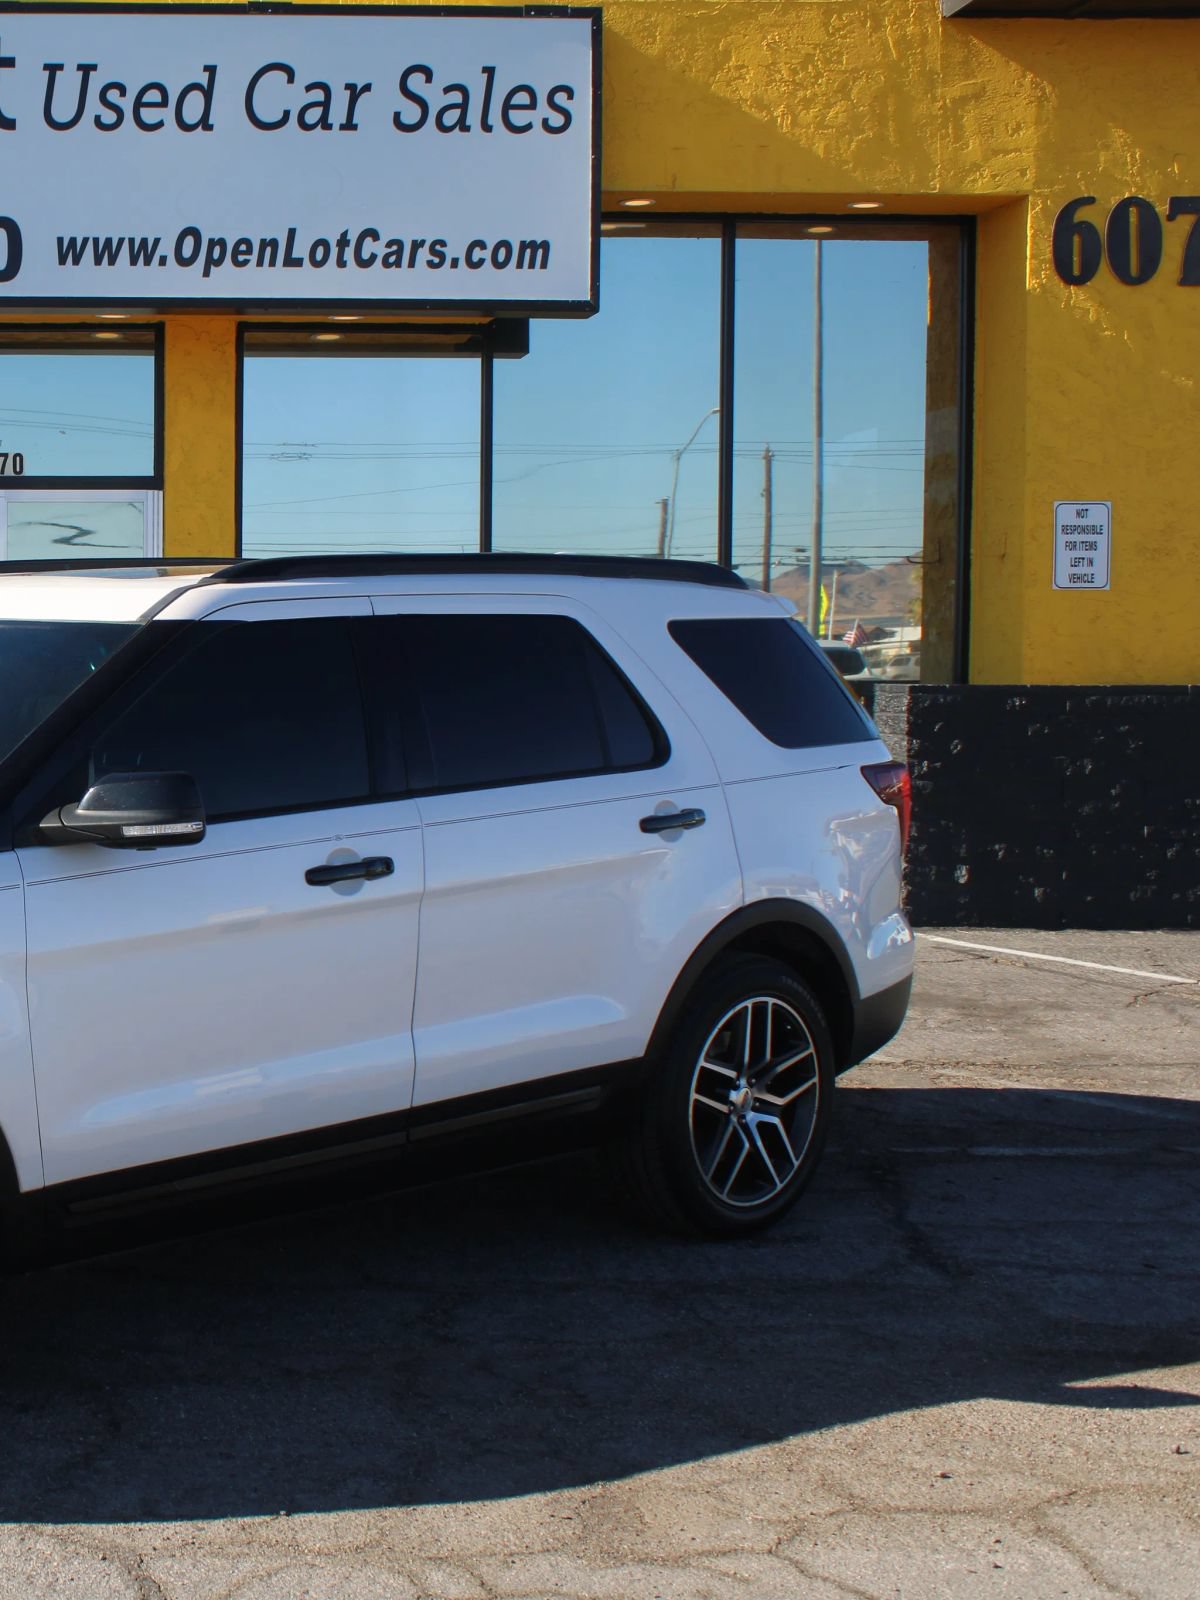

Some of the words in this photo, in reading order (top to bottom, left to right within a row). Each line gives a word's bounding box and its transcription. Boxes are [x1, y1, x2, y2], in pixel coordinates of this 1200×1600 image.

[41, 63, 218, 133] Used
[243, 61, 372, 133] Car
[391, 63, 575, 135] Sales
[55, 225, 551, 278] www.OpenLotCars.com
[1075, 508, 1089, 519] NOT
[1061, 524, 1104, 535] RESPONSIBLE
[1064, 541, 1077, 552] FOR
[1078, 541, 1098, 552] ITEMS
[1070, 557, 1085, 568] LEFT
[1086, 557, 1094, 568] IN
[1068, 573, 1095, 584] VEHICLE
